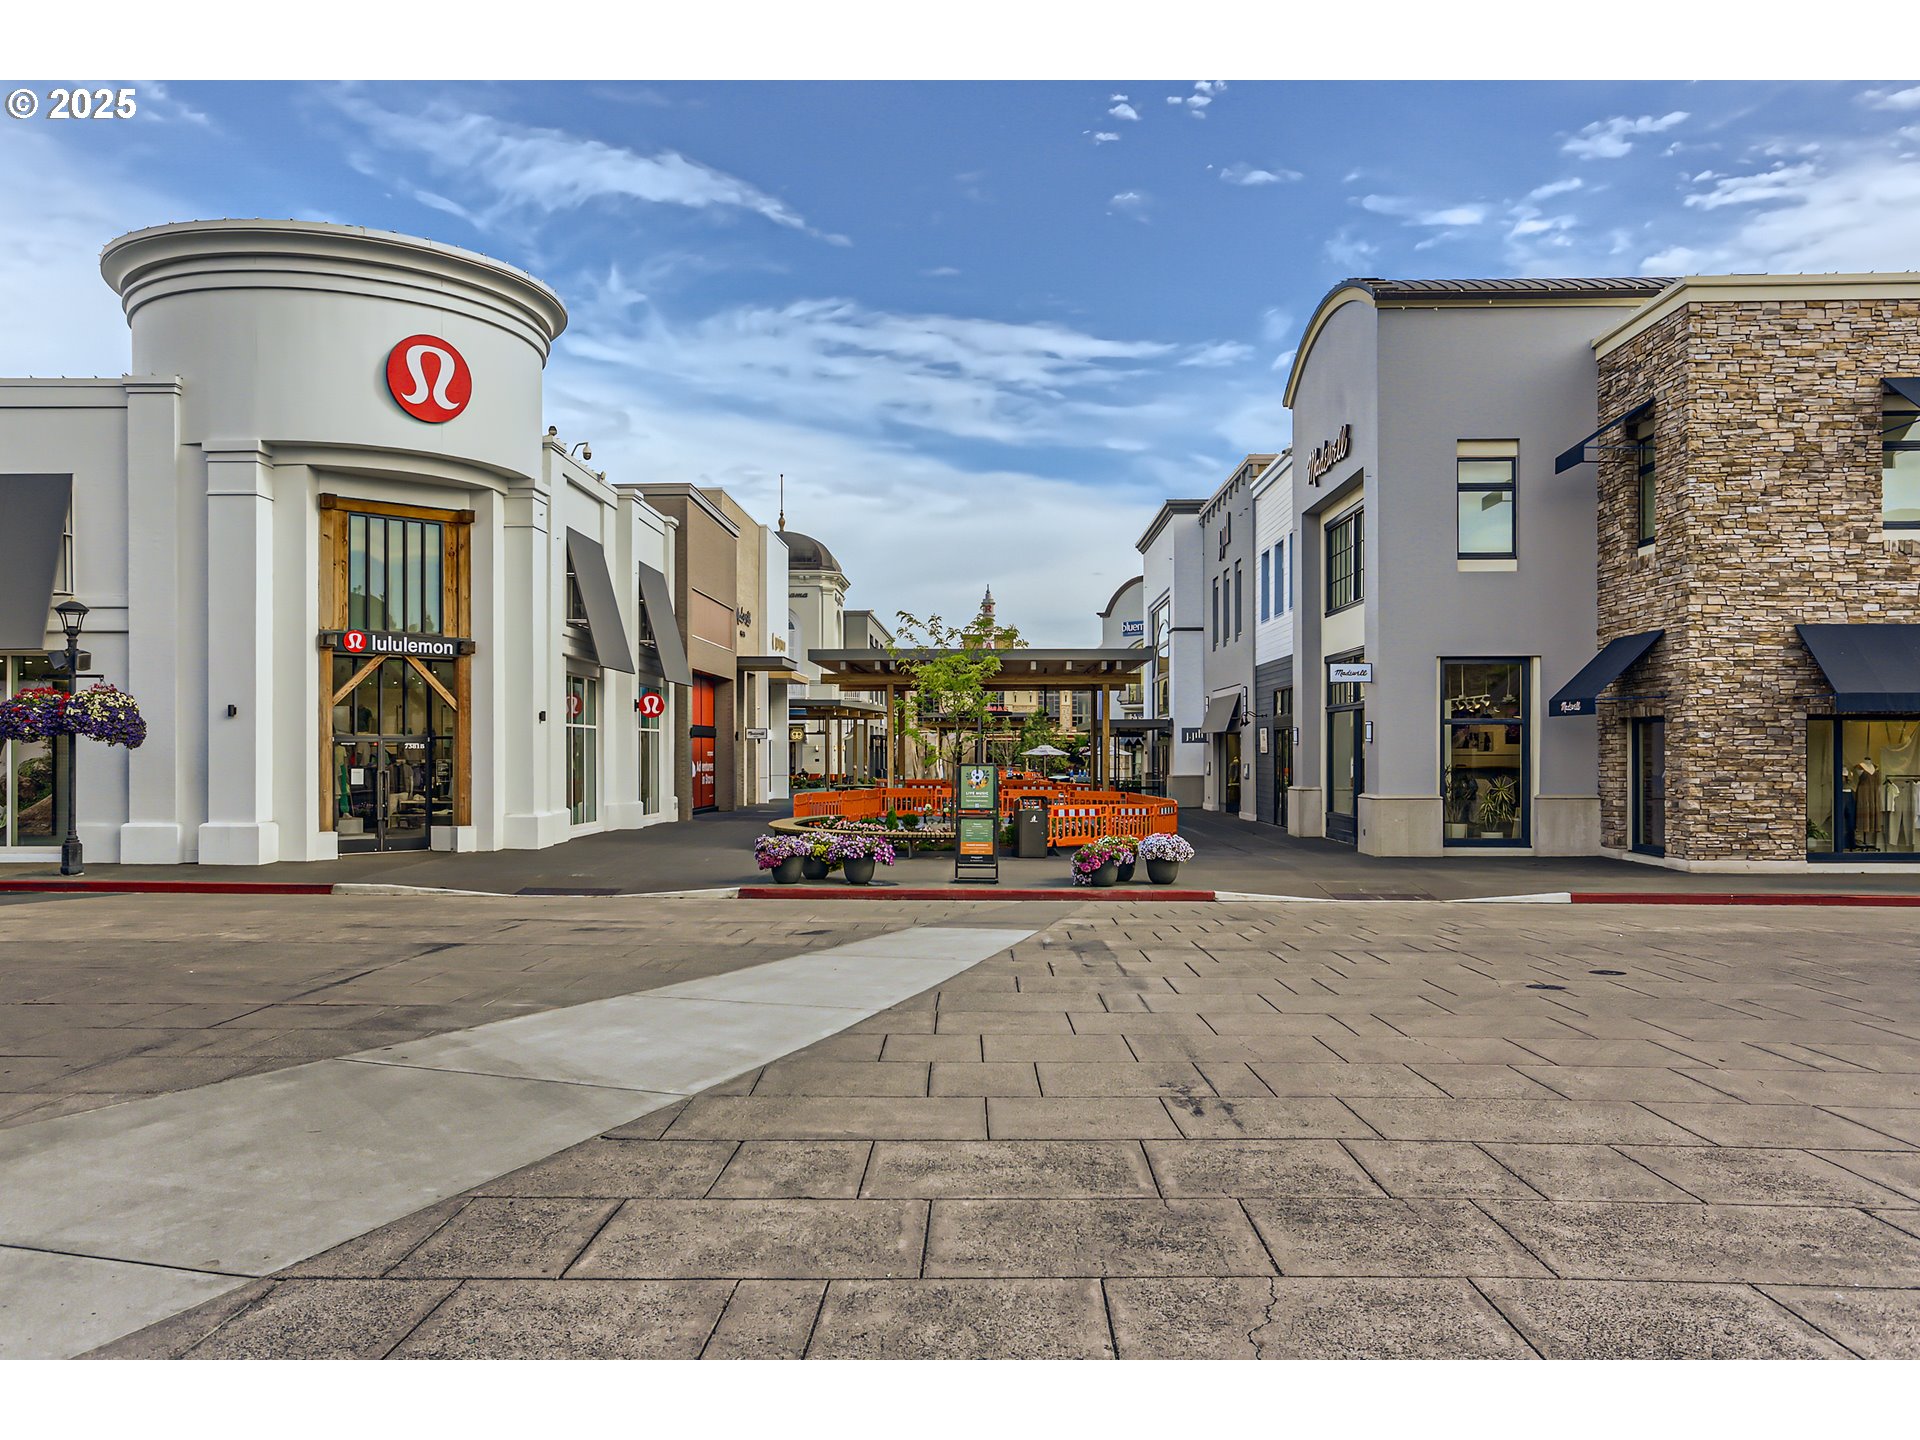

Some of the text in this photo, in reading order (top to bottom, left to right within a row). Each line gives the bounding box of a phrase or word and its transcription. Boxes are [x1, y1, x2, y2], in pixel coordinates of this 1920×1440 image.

[1307, 424, 1351, 487] Madewell
[372, 634, 454, 655] lululemon
[1334, 669, 1368, 677] Madewell
